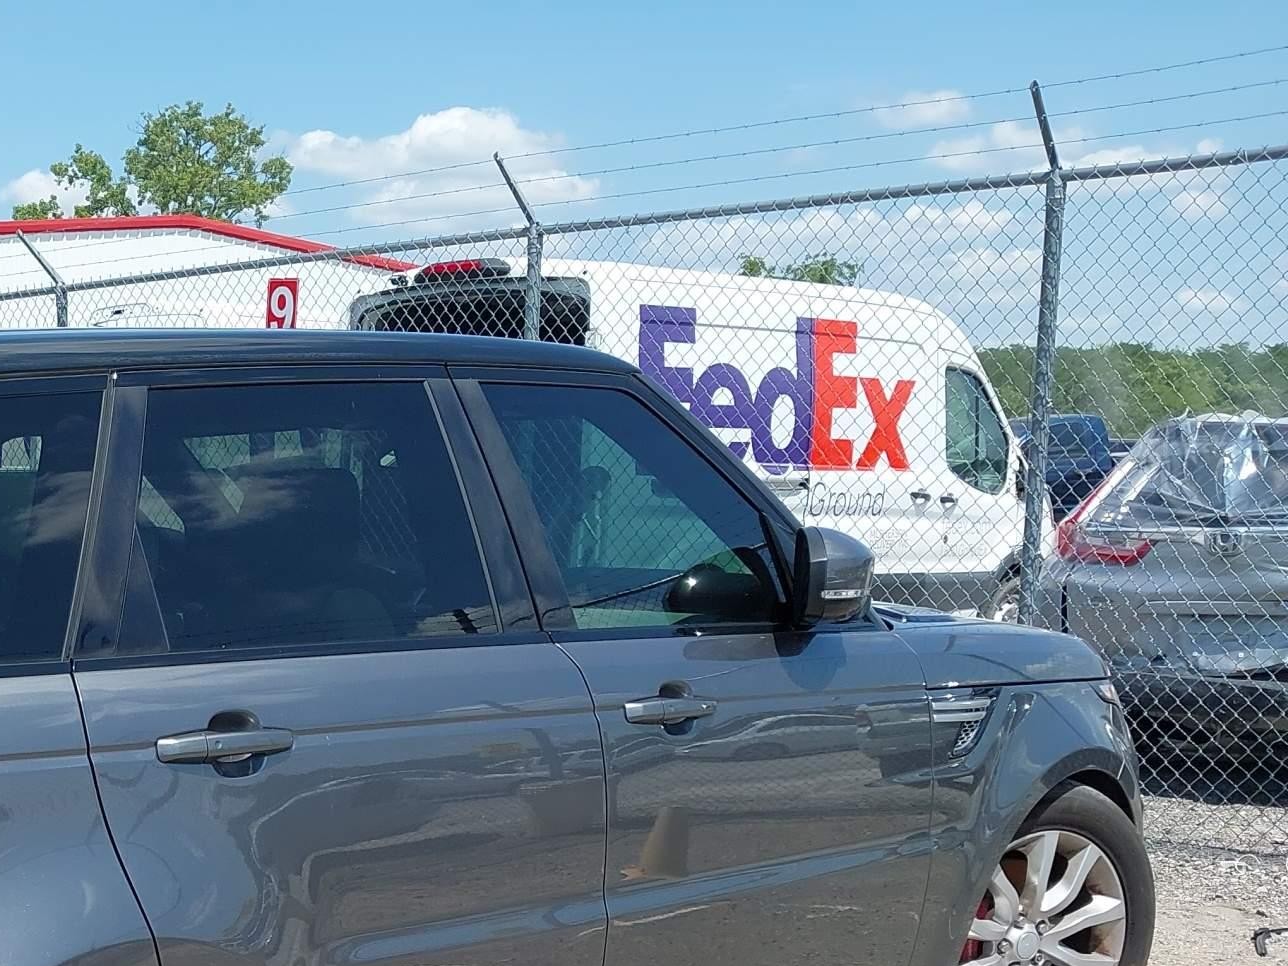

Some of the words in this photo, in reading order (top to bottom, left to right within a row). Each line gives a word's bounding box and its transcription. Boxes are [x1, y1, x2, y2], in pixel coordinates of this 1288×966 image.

[270, 285, 294, 328] 9
[638, 304, 915, 475] FedEx
[809, 482, 886, 517] Ground
